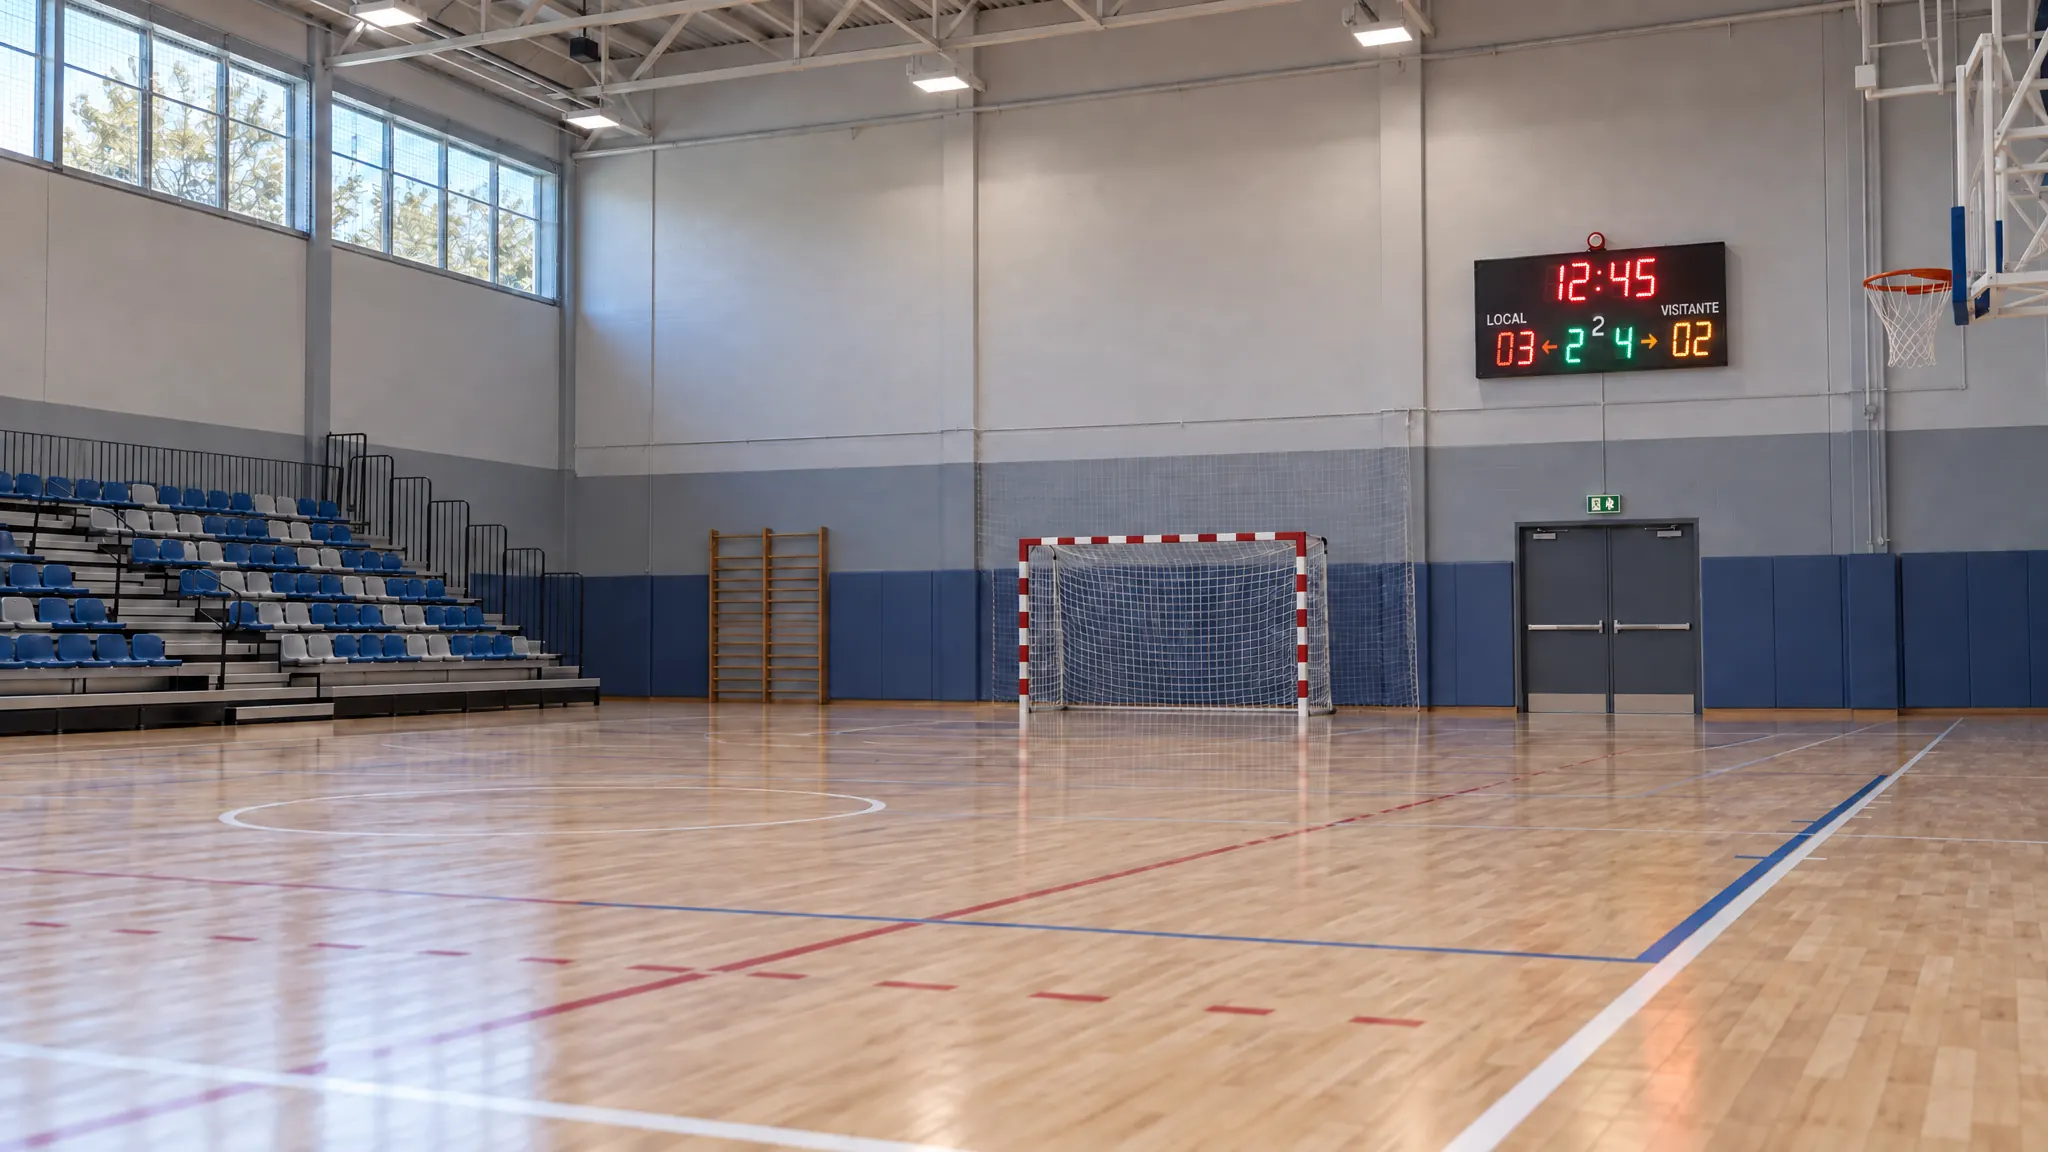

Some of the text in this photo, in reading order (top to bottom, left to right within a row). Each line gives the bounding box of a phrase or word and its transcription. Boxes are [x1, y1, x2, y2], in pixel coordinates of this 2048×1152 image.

[1557, 258, 1656, 302] 12:45
[1486, 312, 1527, 326] LOCAL
[1591, 315, 1605, 337] 2
[1661, 302, 1719, 316] VISITANTE
[1496, 330, 1535, 366] 03
[1565, 328, 1585, 363] 2
[1615, 326, 1633, 359] 4
[1672, 321, 1712, 357] 02
